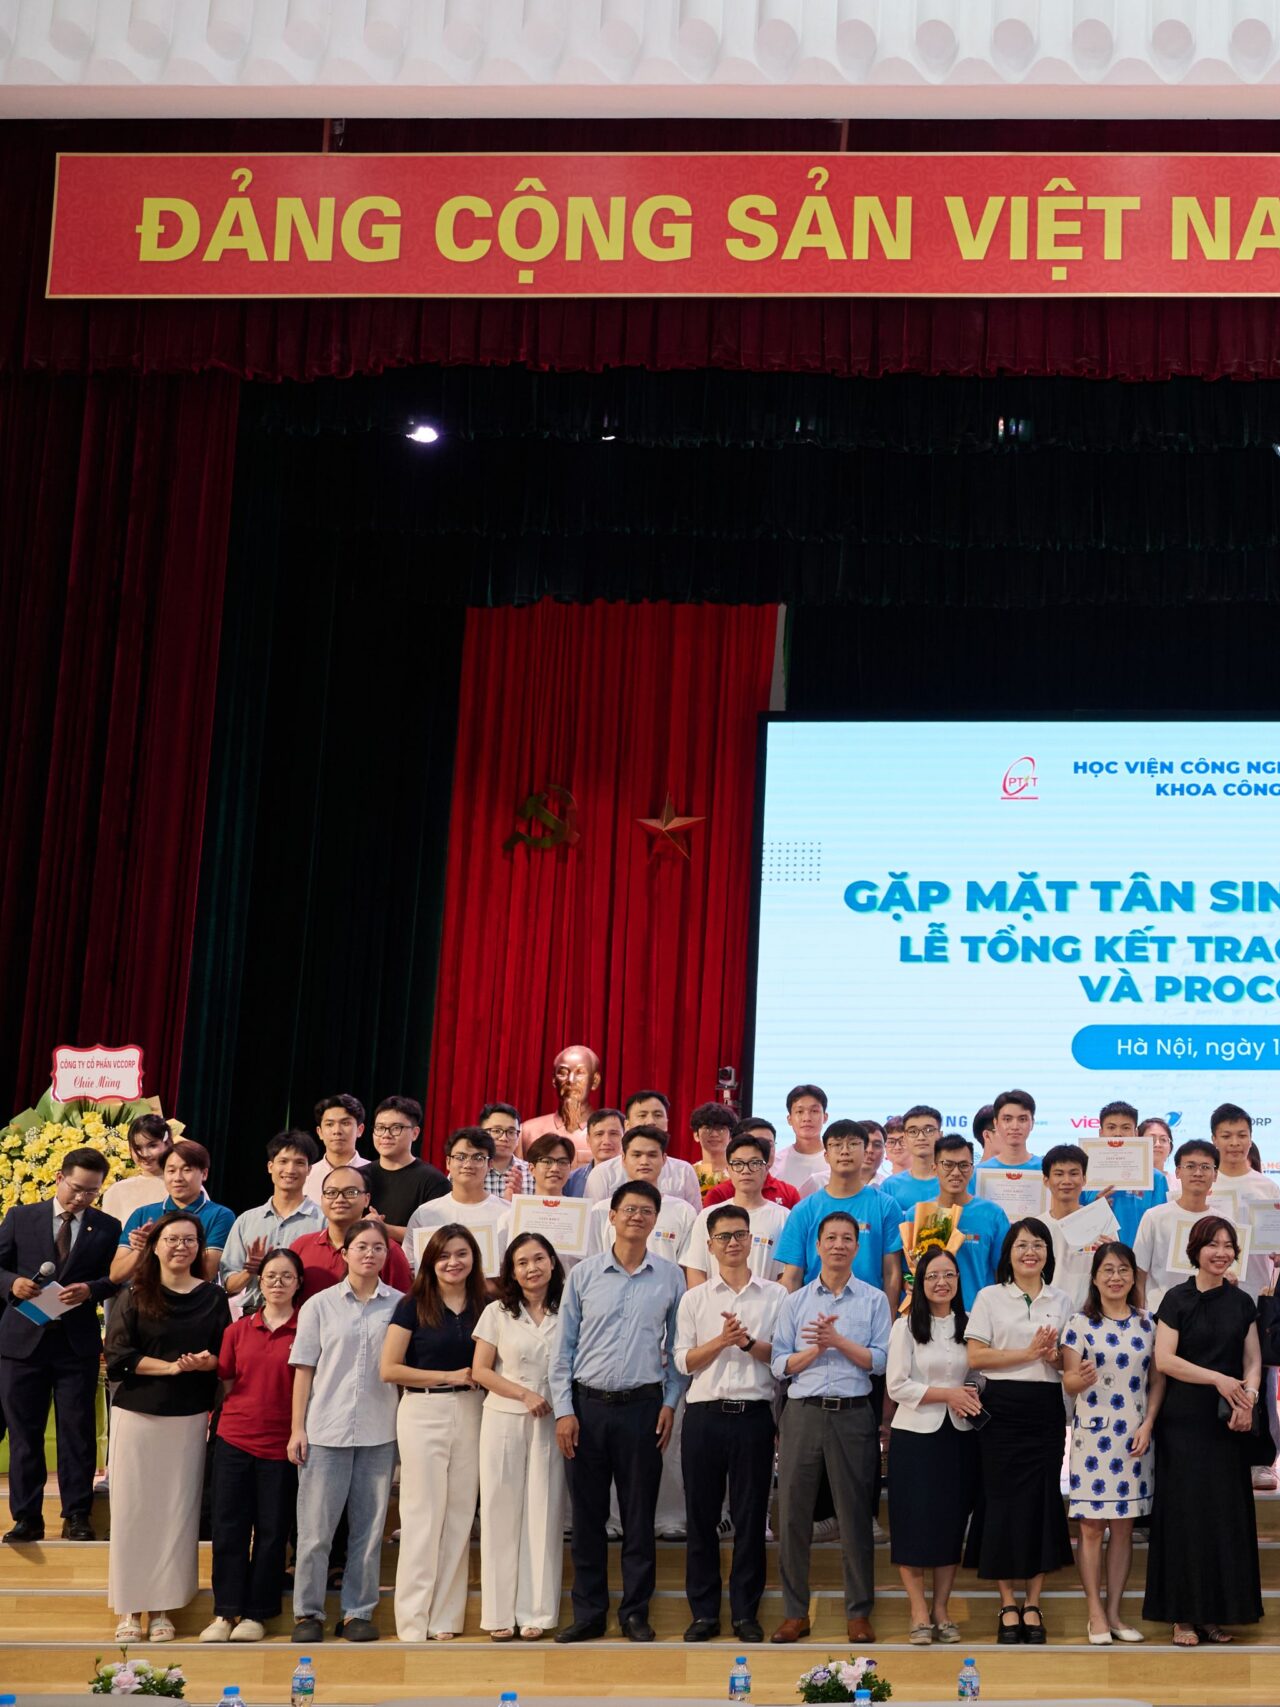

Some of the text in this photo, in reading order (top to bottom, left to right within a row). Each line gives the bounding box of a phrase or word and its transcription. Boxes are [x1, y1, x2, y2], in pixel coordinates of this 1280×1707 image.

[136, 168, 402, 262] ĐẢNG
[436, 178, 692, 283] CỘNG
[726, 167, 912, 261] SẢN
[945, 178, 1140, 281] VIỆT
[1074, 761, 1118, 778] HỌC
[1125, 758, 1173, 778] VIỆN
[1181, 758, 1240, 774] CÔNG
[1156, 784, 1216, 797] KHOA
[844, 872, 951, 921] GẶP
[967, 872, 1078, 921] MẶT
[1090, 872, 1195, 913] TÂN
[900, 922, 949, 963] LỄ
[961, 924, 1081, 963] TỔNG
[1095, 925, 1176, 963] KẾT
[1079, 968, 1142, 1003] VÀ
[1118, 1039, 1147, 1056] Hà
[1157, 1038, 1198, 1060] Nội,
[1206, 1039, 1265, 1061] ngày
[60, 1058, 76, 1069] CÔNG
[78, 1061, 85, 1069] TY
[113, 1060, 136, 1069] VCCORP
[73, 1075, 94, 1088] Chúc
